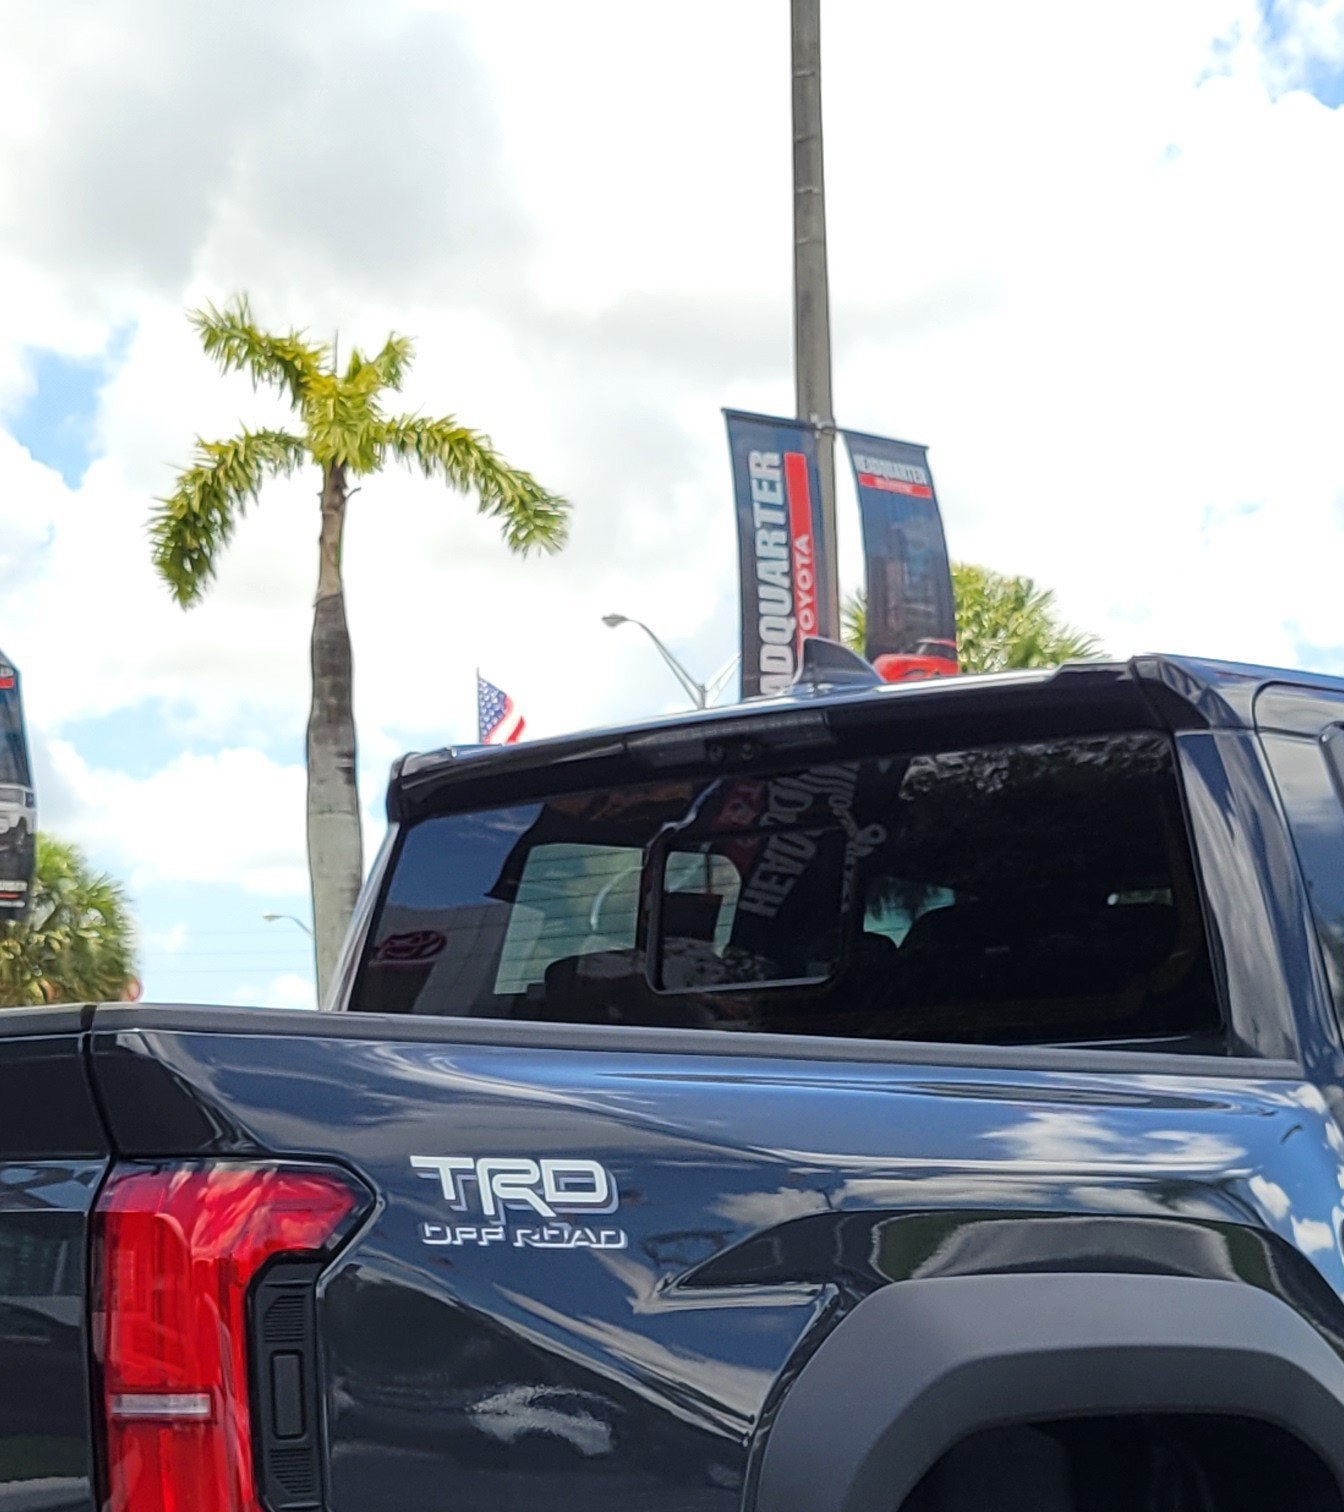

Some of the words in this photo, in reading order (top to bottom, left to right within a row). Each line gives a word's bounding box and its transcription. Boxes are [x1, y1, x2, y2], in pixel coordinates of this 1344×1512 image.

[748, 450, 796, 697] ADQUARTER
[792, 534, 816, 636] OYOTA
[410, 1155, 607, 1217] TRD
[423, 1222, 507, 1246] OFF
[513, 1224, 628, 1249] ROAD
